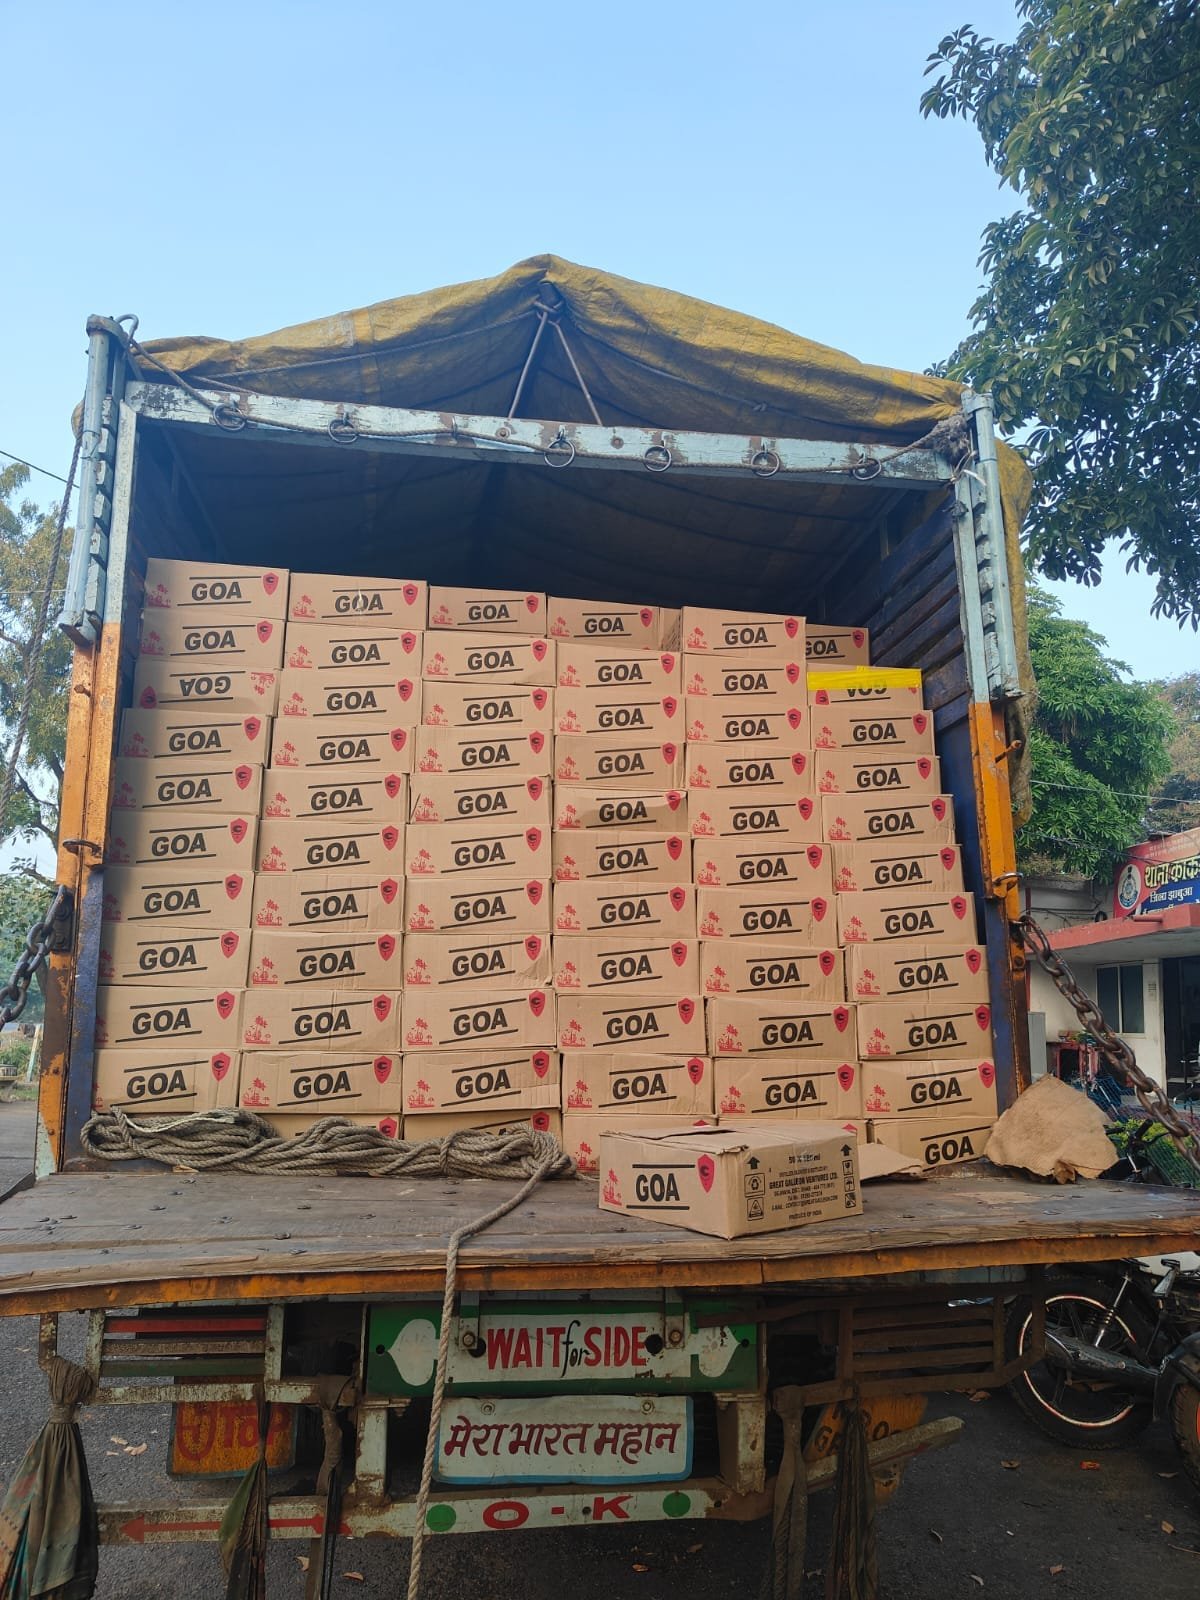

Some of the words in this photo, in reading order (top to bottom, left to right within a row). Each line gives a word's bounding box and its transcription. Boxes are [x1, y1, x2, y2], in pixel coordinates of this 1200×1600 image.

[191, 581, 242, 602] GOA
[334, 593, 384, 614] GOA
[468, 604, 510, 621] GOA
[584, 617, 625, 634] GOA
[724, 626, 769, 646] GOA
[184, 630, 236, 651] GOA
[331, 643, 381, 664] GOA
[467, 650, 515, 671] GOA
[597, 663, 643, 683] GOA
[724, 673, 769, 692] GOA
[179, 675, 231, 697] GOA
[326, 690, 378, 712] GOA
[466, 700, 514, 722] GOA
[598, 707, 645, 728] GOA
[725, 718, 770, 738] GOA
[169, 729, 222, 752] GOA
[852, 722, 897, 743] GOA
[319, 738, 371, 761] GOA
[461, 743, 511, 767] GOA
[598, 752, 645, 775] GOA
[728, 762, 775, 784] GOA
[857, 768, 901, 788] GOA
[158, 779, 211, 801] GOA
[311, 788, 362, 810] GOA
[458, 792, 507, 814] GOA
[599, 801, 647, 822] GOA
[733, 810, 779, 830] GOA
[869, 812, 915, 834] GOA
[152, 833, 206, 856] GOA
[307, 841, 360, 864] GOA
[455, 842, 505, 866] GOA
[599, 848, 648, 871] GOA
[740, 858, 788, 879] GOA
[875, 862, 922, 884] GOA
[1145, 863, 1169, 888] थाना
[1170, 857, 1200, 882] काक
[144, 889, 200, 913] GOA
[304, 894, 358, 919] GOA
[455, 896, 506, 921] GOA
[601, 900, 651, 923] GOA
[743, 909, 792, 931] GOA
[885, 910, 934, 934] GOA
[140, 945, 196, 970] GOA
[300, 951, 355, 976] GOA
[453, 950, 505, 976] GOA
[601, 955, 652, 980] GOA
[750, 963, 800, 986] GOA
[899, 963, 948, 987] GOA
[133, 1008, 191, 1034] GOA
[295, 1010, 351, 1036] GOA
[454, 1008, 507, 1035] GOA
[607, 1013, 658, 1038] GOA
[762, 1021, 813, 1045] GOA
[909, 1021, 957, 1047] GOA
[127, 1070, 186, 1098] GOA
[294, 1071, 351, 1098] GOA
[456, 1069, 511, 1097] GOA
[613, 1074, 666, 1099] GOA
[766, 1080, 817, 1105] GOA
[911, 1078, 961, 1103] GOA
[925, 1136, 975, 1165] GOA
[636, 1173, 680, 1201] GOA
[769, 1180, 785, 1189] GREAT
[486, 1326, 566, 1370] WAIT
[584, 1325, 647, 1369] SIDE
[444, 1415, 511, 1458] मेरा
[508, 1422, 594, 1457] भारत
[594, 1422, 682, 1465] महान
